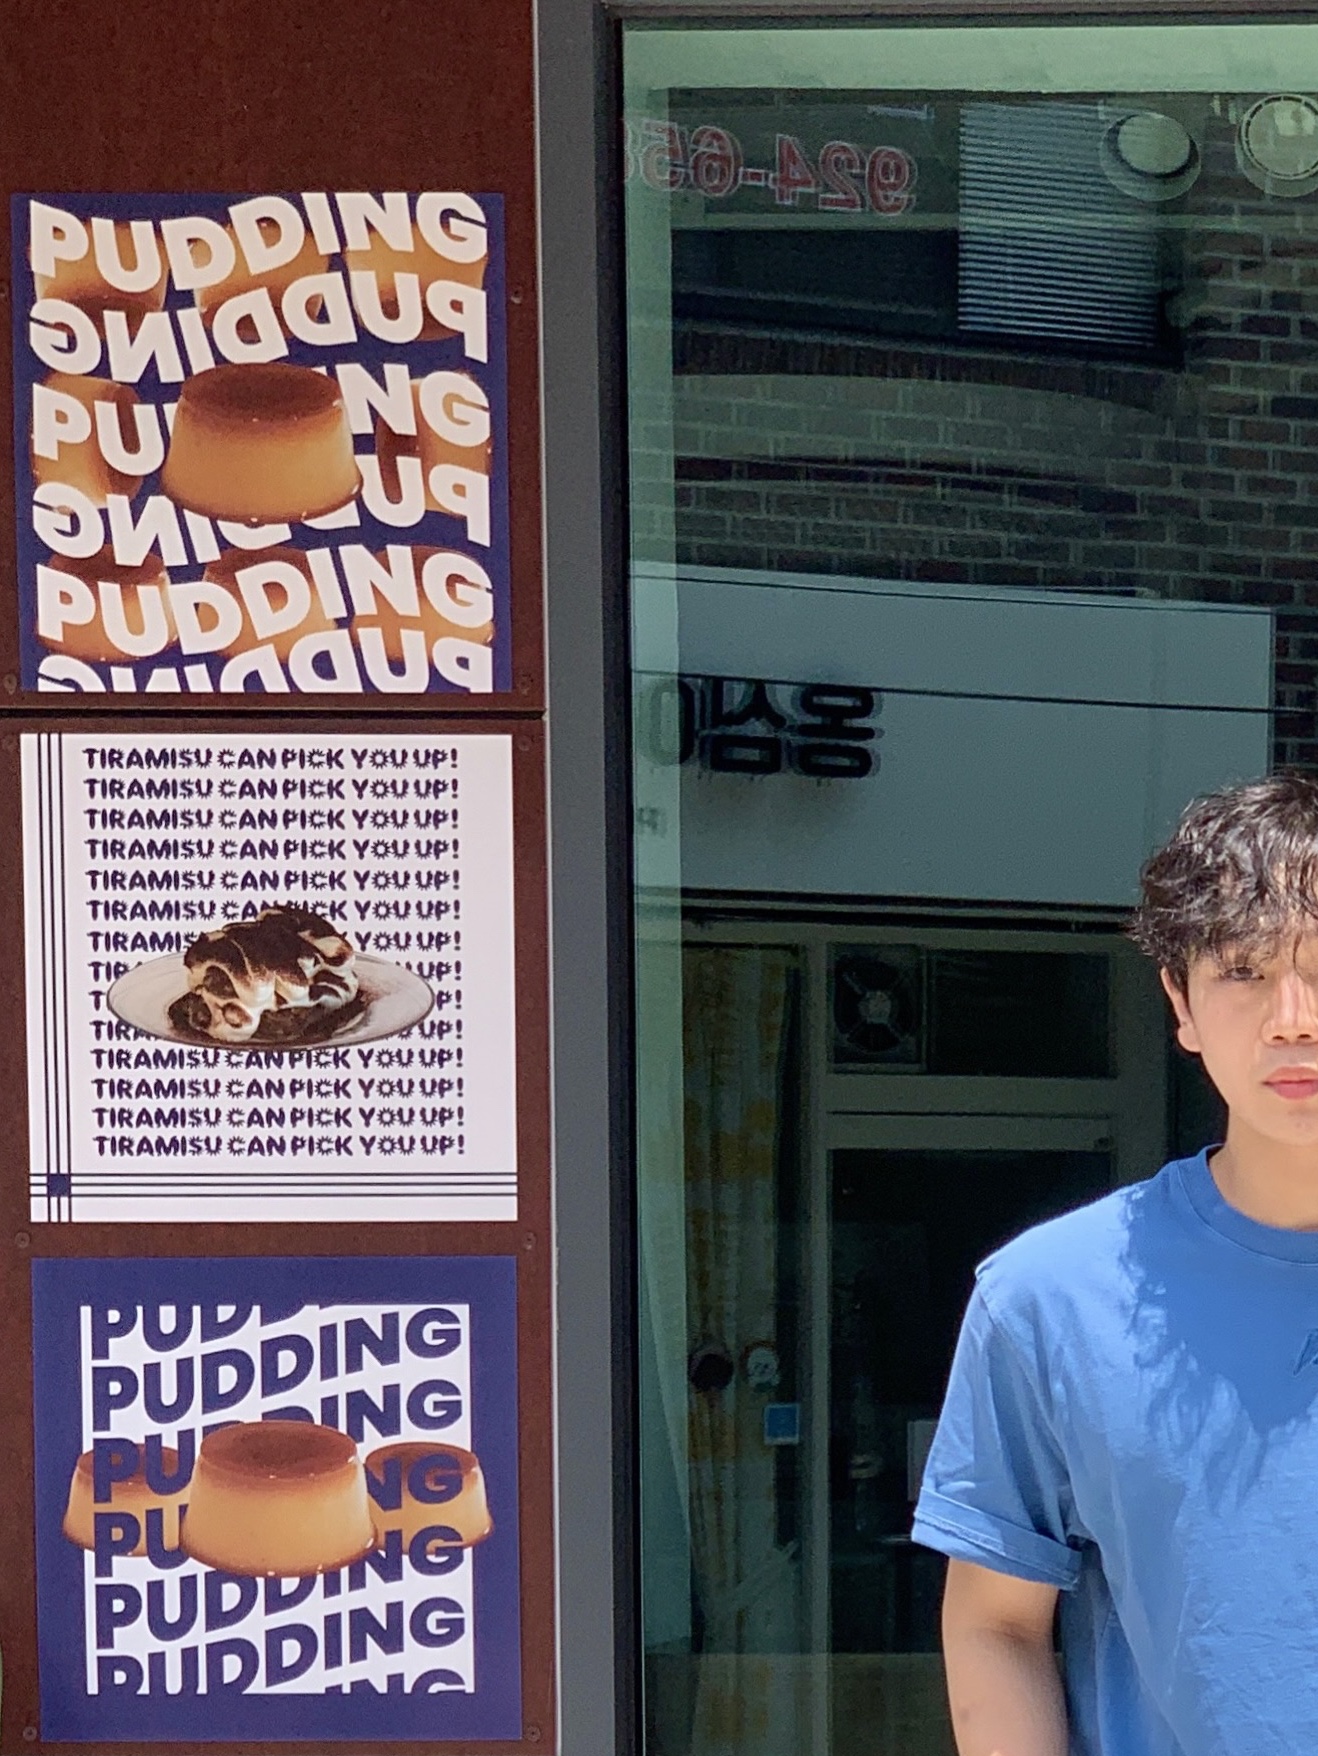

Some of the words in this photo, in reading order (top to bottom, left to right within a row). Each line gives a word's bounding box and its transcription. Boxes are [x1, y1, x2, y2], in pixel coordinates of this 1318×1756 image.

[30, 191, 487, 293] PUDDING
[33, 363, 490, 476] PUNG
[36, 545, 493, 657] PUDDING
[82, 748, 212, 769] TIRAMISU
[217, 748, 276, 769] CAN
[282, 749, 344, 769] PICK
[351, 749, 408, 769] YOU
[413, 748, 457, 769] UP!
[83, 779, 213, 799] TIRAMISU
[218, 779, 277, 799] CAN
[282, 779, 345, 799] PICK
[352, 779, 409, 799] YOU
[414, 779, 458, 799] UP!
[83, 809, 213, 829] TIRAMISU
[219, 809, 277, 829] CAN
[283, 809, 345, 829] PICK
[352, 809, 409, 829] YOU
[414, 809, 458, 829] UP!
[84, 839, 214, 859] TIRAMISU
[219, 839, 278, 860] CAN
[284, 839, 346, 860] PICK
[353, 839, 410, 859] YOU
[415, 839, 459, 860] UP!
[84, 870, 215, 890] TIRAMISU
[220, 870, 279, 891] CAN
[284, 870, 346, 891] PICK
[354, 870, 410, 891] YOU
[415, 870, 459, 890] UP!
[85, 900, 216, 920] TIRAMISU
[354, 900, 411, 920] YOU
[416, 900, 460, 921] UP!
[86, 931, 198, 952] TIRAMIS
[355, 932, 411, 953] YOU
[416, 931, 460, 952] UP!
[417, 960, 462, 982] UP!
[436, 989, 462, 1011] P!
[418, 1019, 462, 1041] UP!
[89, 1048, 221, 1069] TIRAMISU
[225, 1048, 284, 1069] CAN
[289, 1048, 351, 1069] PICK
[358, 1048, 414, 1069] YOU
[419, 1048, 462, 1069] UP!
[90, 1079, 221, 1099] TIRAMISU
[226, 1079, 284, 1099] CAN
[290, 1079, 351, 1099] PICK
[358, 1078, 414, 1098] YOU
[419, 1078, 463, 1098] UP!
[91, 1108, 221, 1128] TIRAMISU
[227, 1108, 285, 1128] CAN
[290, 1107, 352, 1127] PICK
[359, 1107, 415, 1127] YOU
[420, 1106, 463, 1127] UP!
[92, 1136, 222, 1156] TIRAMISU
[227, 1136, 286, 1156] CAN
[291, 1136, 353, 1156] PICK
[360, 1136, 415, 1156] YOU
[420, 1135, 464, 1155] UP!
[92, 1308, 462, 1431] PUDDING
[93, 1454, 463, 1578] PUNG
